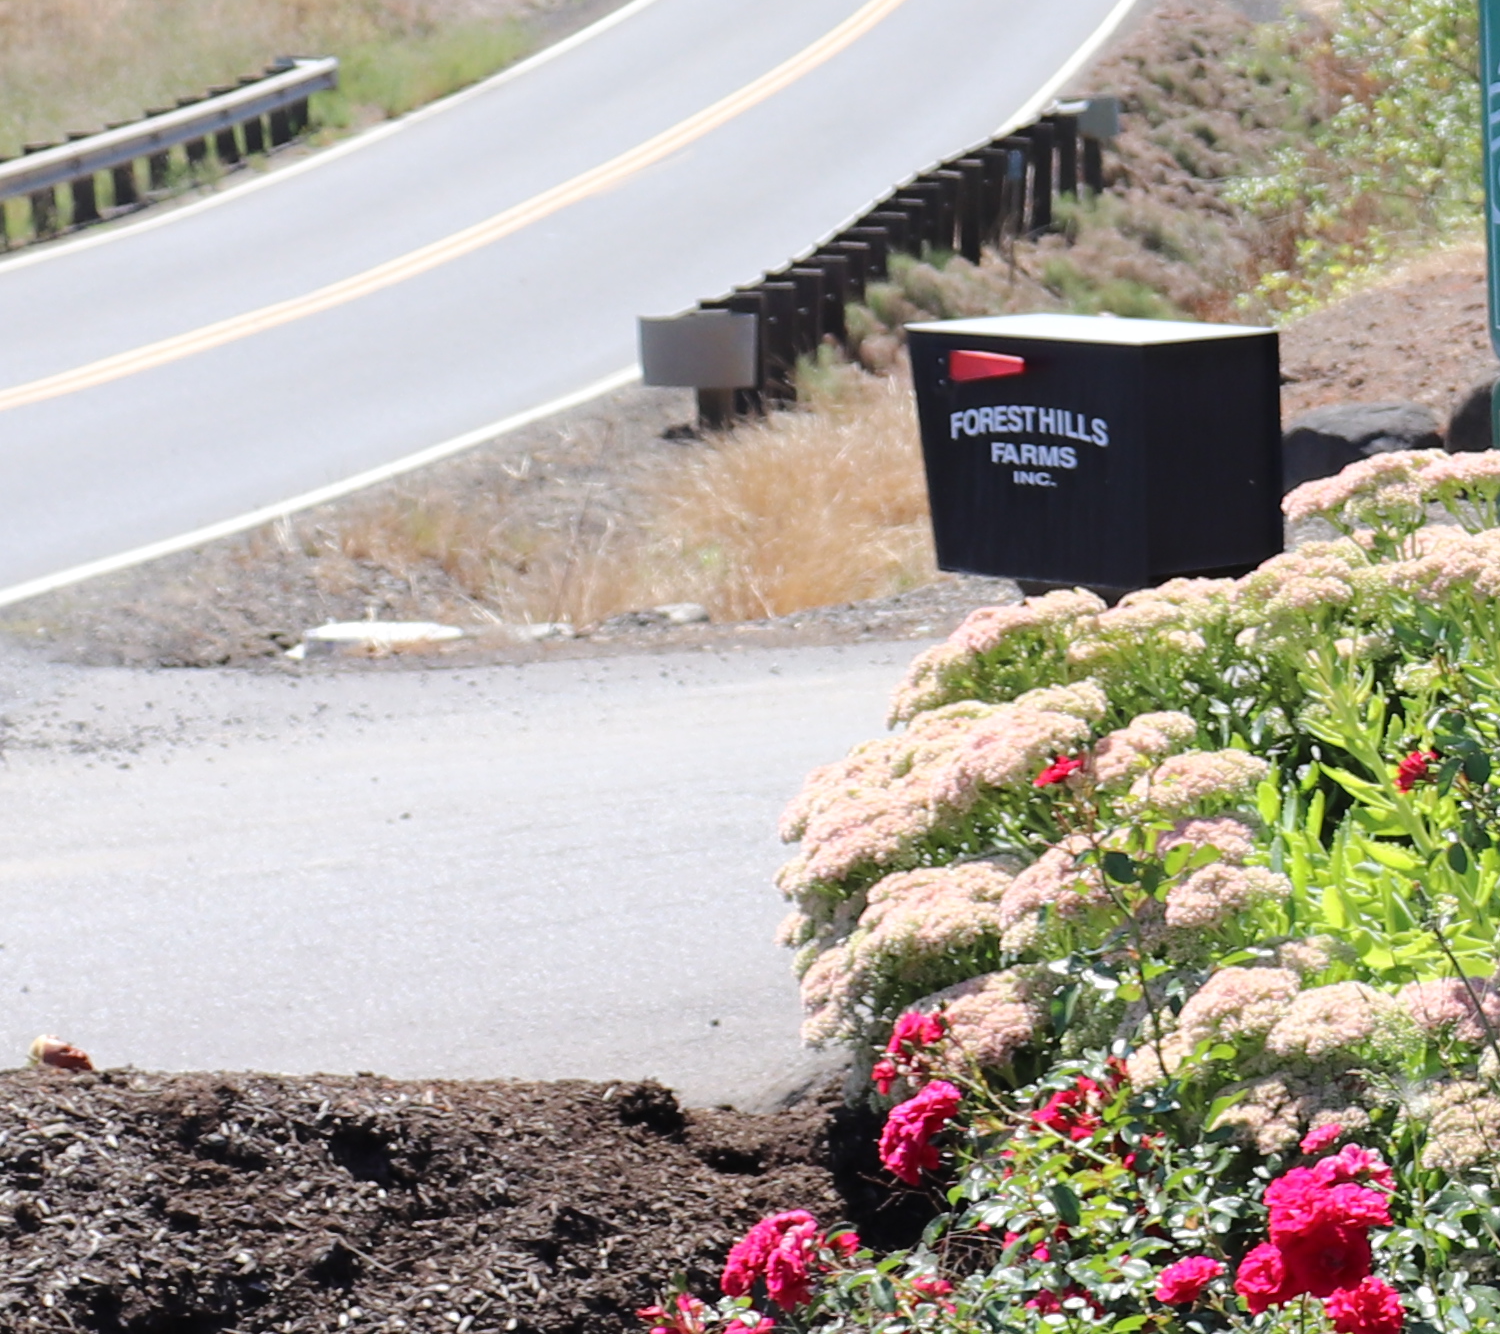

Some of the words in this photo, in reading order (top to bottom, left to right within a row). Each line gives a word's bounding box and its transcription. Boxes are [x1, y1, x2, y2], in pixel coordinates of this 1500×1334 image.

[950, 405, 1036, 440] FOREST
[1038, 407, 1109, 448] HILLS
[991, 442, 1078, 469] FARMS
[1013, 470, 1057, 486] INC.
